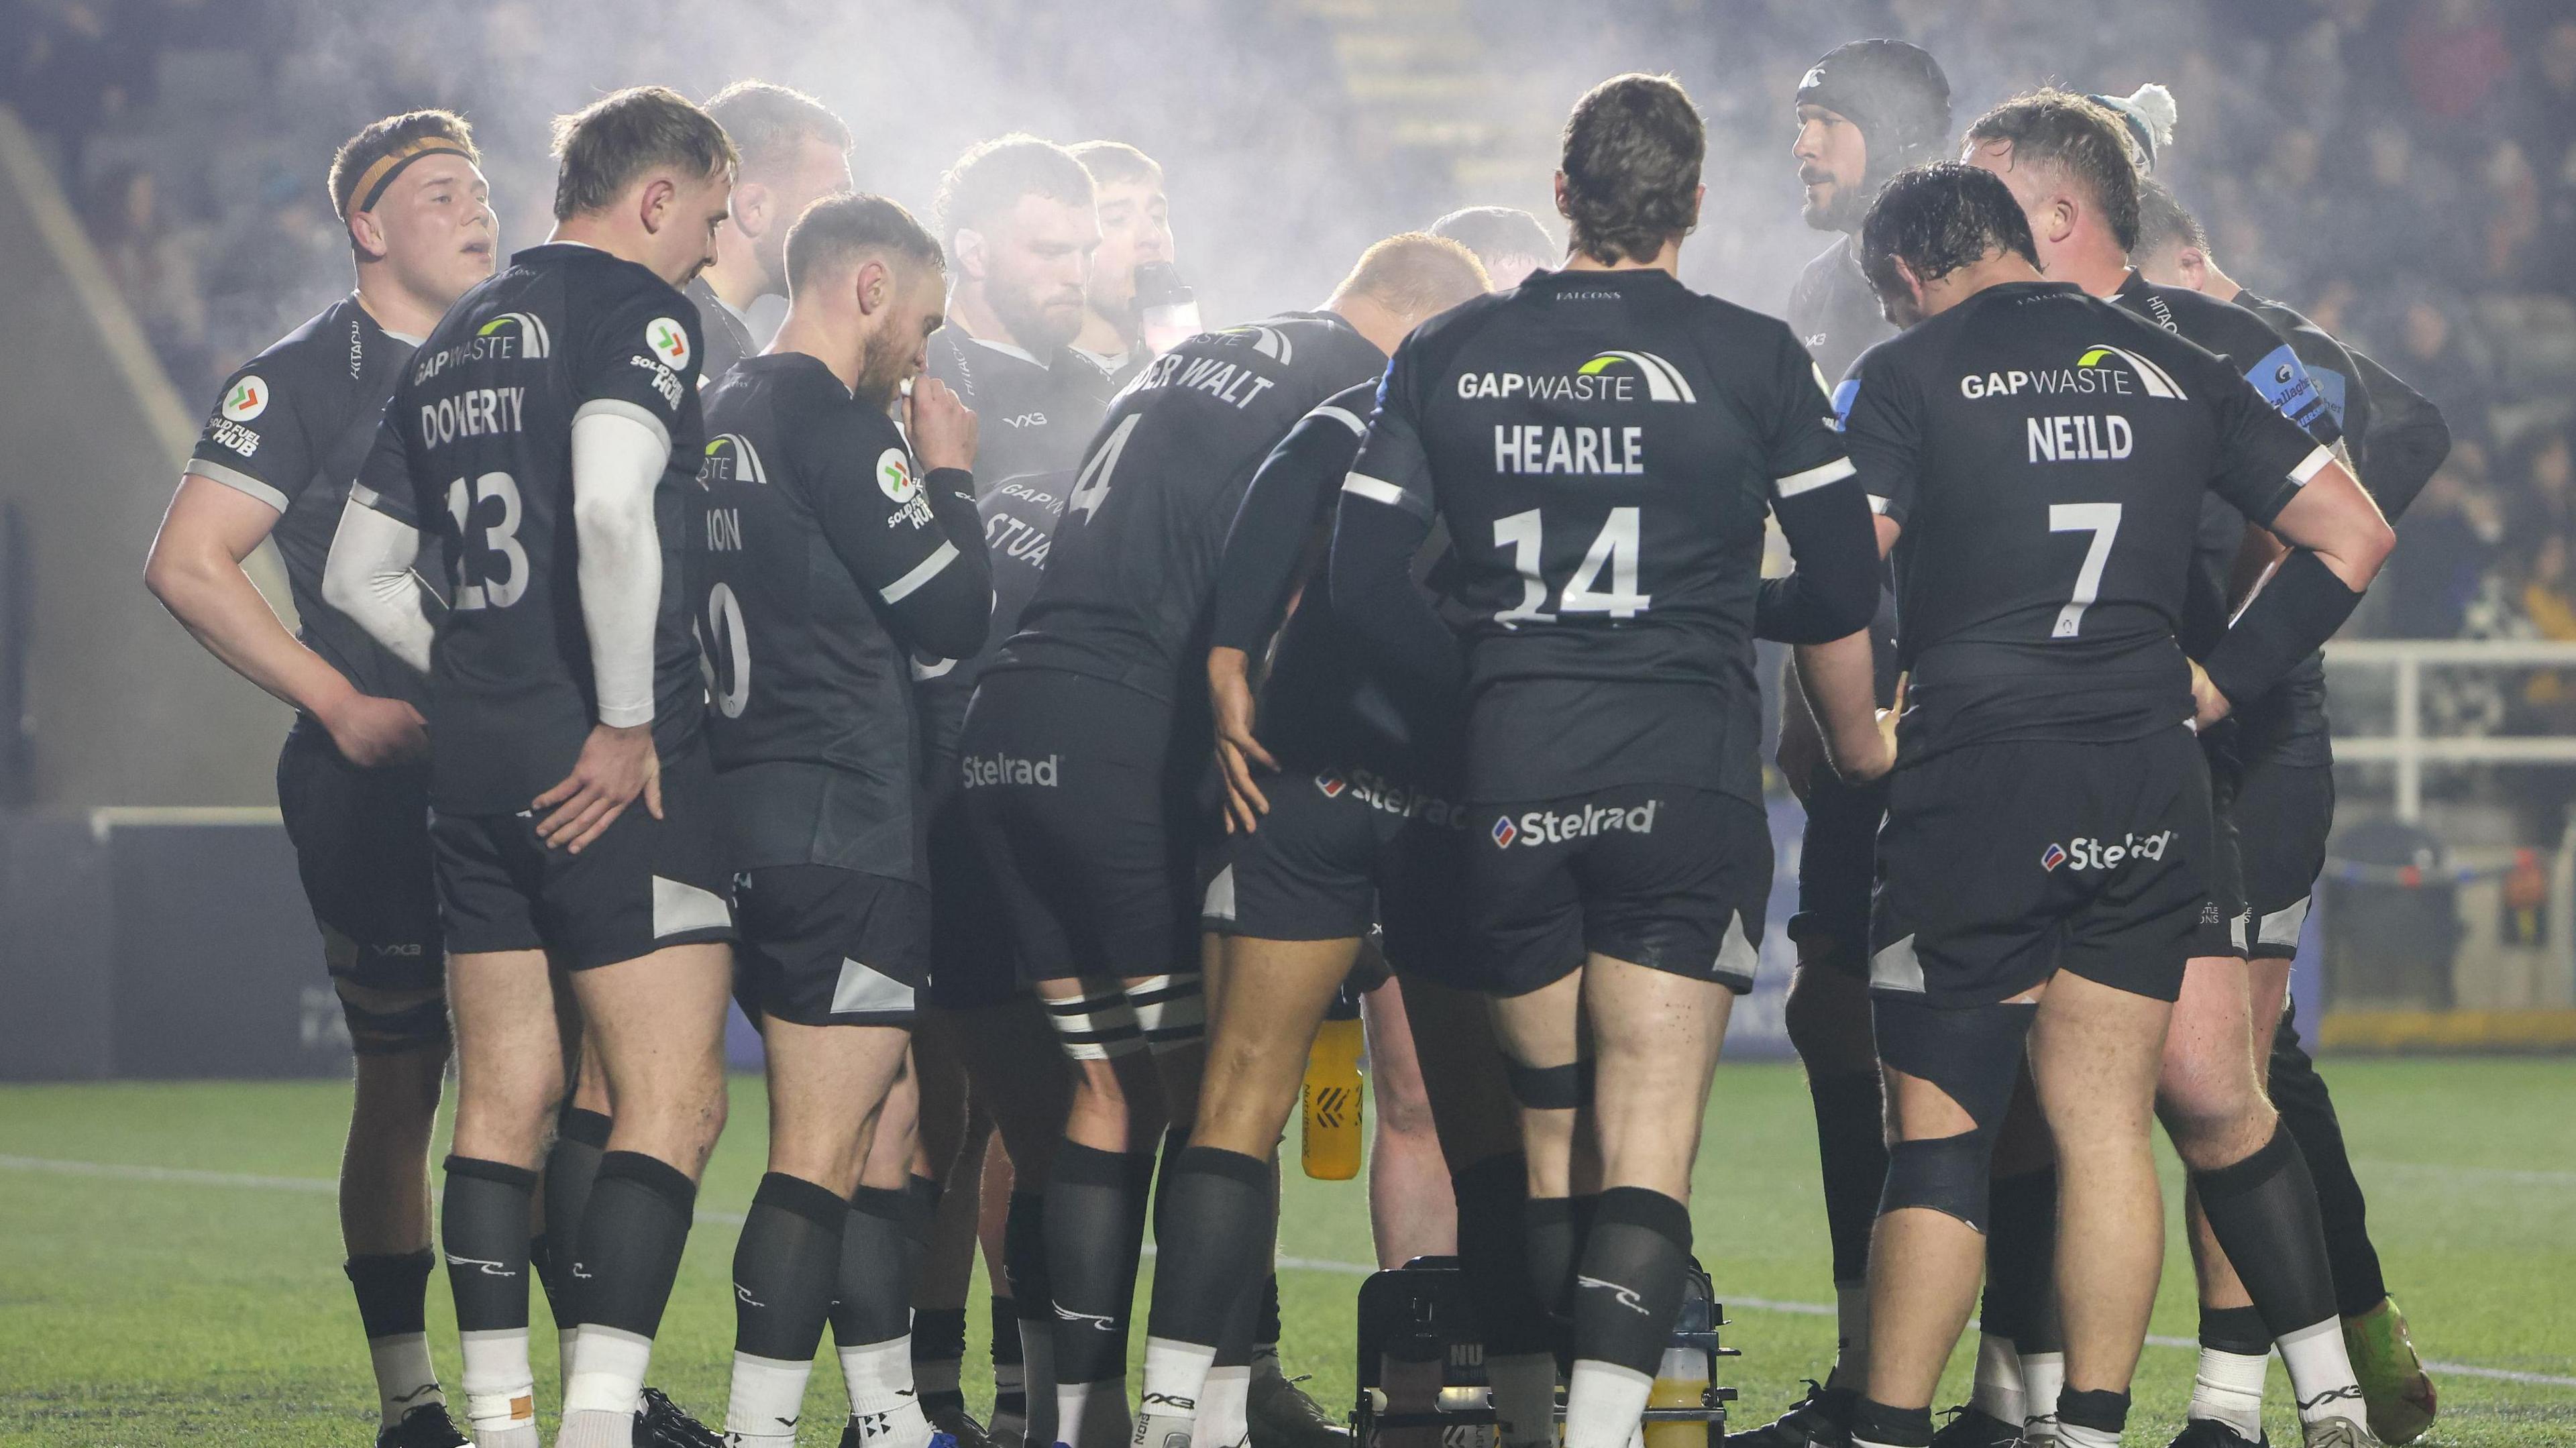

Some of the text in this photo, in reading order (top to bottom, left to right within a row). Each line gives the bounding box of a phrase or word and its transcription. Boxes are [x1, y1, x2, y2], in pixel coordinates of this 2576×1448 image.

[1556, 291, 1621, 300] FALCONS
[415, 336, 515, 386] GAPWASTE
[631, 355, 671, 378] SOLID
[1176, 357, 1275, 409] WALT
[1961, 368, 2133, 400] GAPWASTE
[1458, 373, 1633, 400] GAPWASTE
[231, 424, 260, 446] FUEL
[421, 386, 525, 450] DOHERTY
[1002, 412, 1048, 429] VX3
[2027, 414, 2133, 463] NEILD
[213, 429, 257, 457] HUB
[1495, 425, 1644, 474] HEARLE
[1069, 413, 1142, 526] 4
[888, 503, 913, 528] SOLID
[445, 471, 529, 609] 13
[1493, 507, 1651, 629] 14
[2049, 503, 2122, 638] 7
[963, 751, 1059, 789] Stelrad
[1520, 799, 1657, 846] Stelrad
